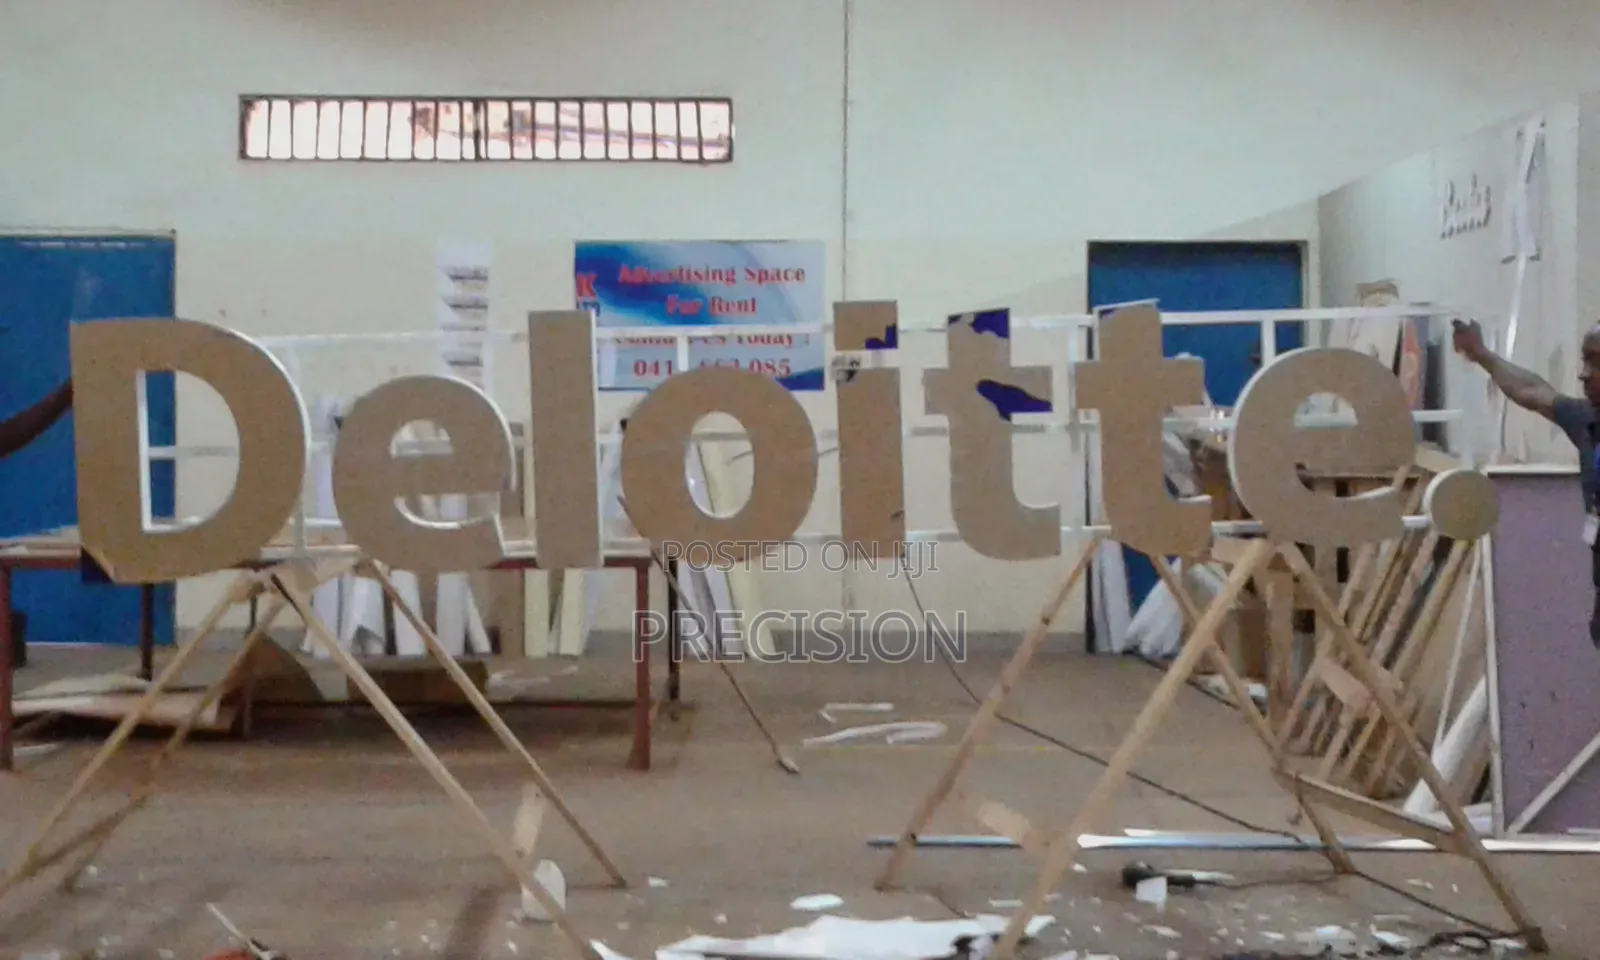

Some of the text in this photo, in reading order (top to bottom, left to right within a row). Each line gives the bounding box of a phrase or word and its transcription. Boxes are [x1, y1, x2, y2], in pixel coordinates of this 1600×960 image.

[618, 264, 806, 286] Advertising Space
[666, 295, 757, 316] For Rent
[633, 359, 674, 377] 041
[69, 298, 1500, 583] Deloitte.
